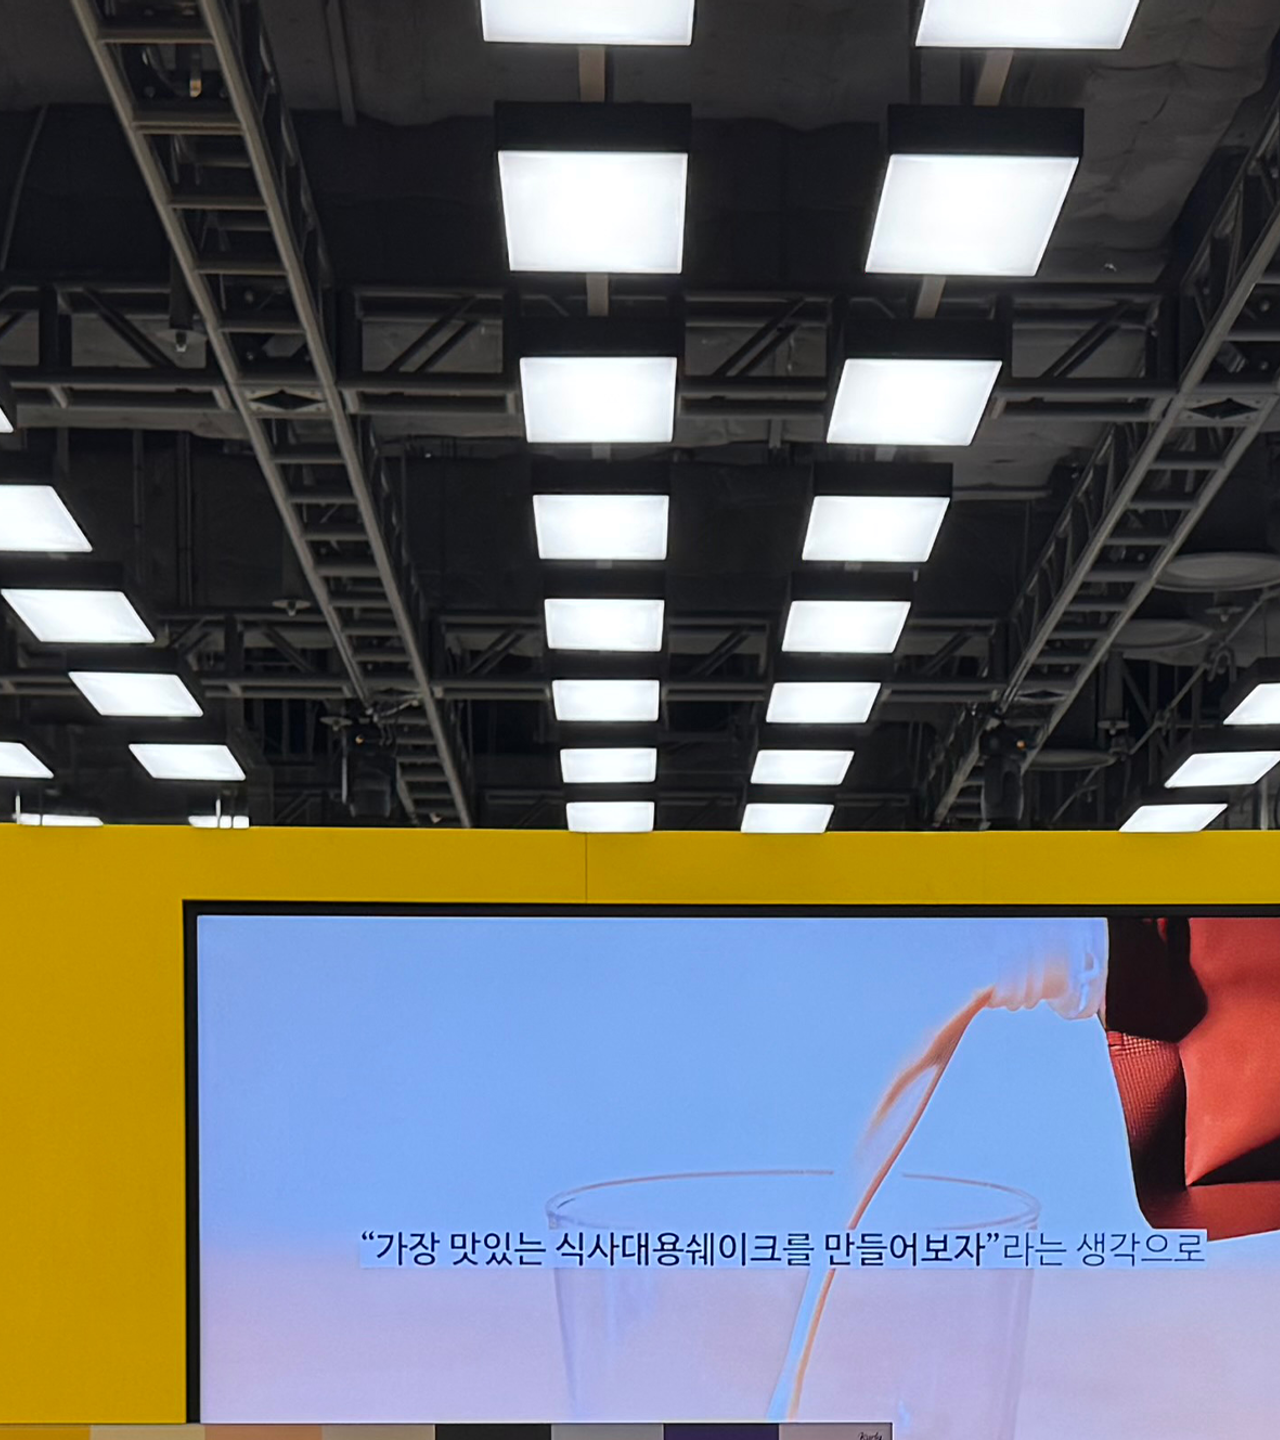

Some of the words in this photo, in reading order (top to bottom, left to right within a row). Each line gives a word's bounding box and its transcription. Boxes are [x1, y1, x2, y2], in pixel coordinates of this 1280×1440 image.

[451, 1231, 546, 1266] 맛있는
[556, 1231, 815, 1266] 식사대용쉐이크를
[1076, 1231, 1205, 1266] 생각으로
